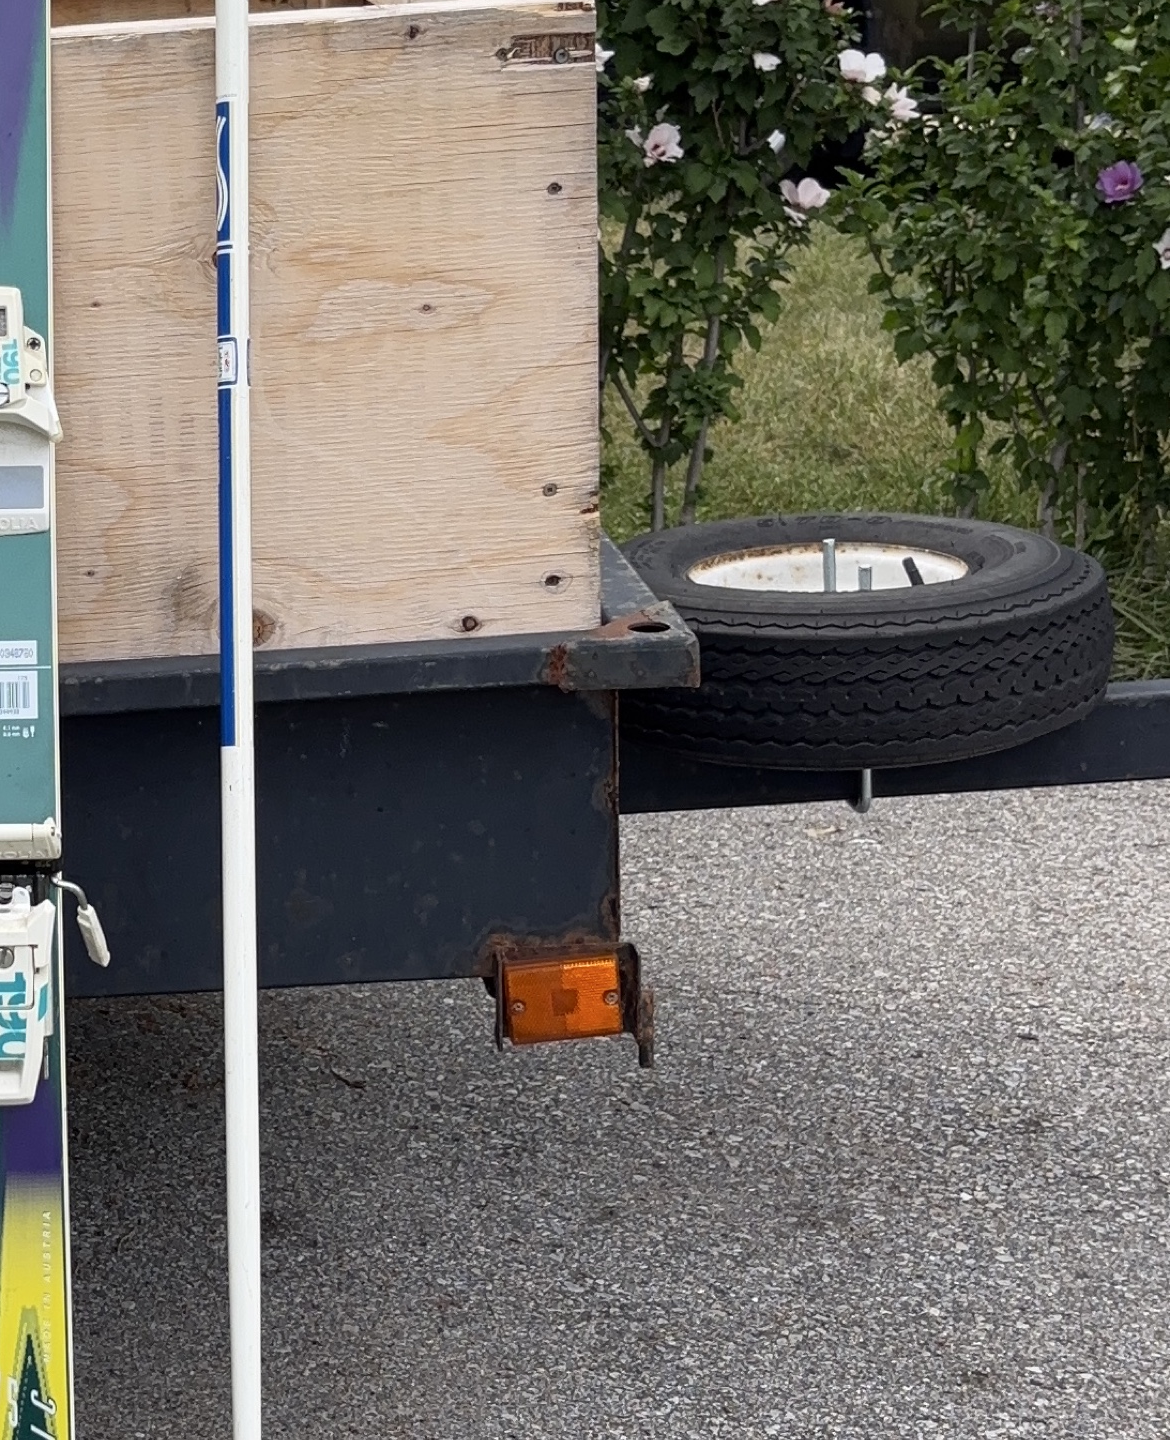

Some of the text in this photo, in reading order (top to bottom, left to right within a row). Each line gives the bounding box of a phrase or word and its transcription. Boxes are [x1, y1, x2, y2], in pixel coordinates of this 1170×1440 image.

[2, 339, 20, 384] 190
[42, 1211, 52, 1364] MADE IN AUSTRIA
